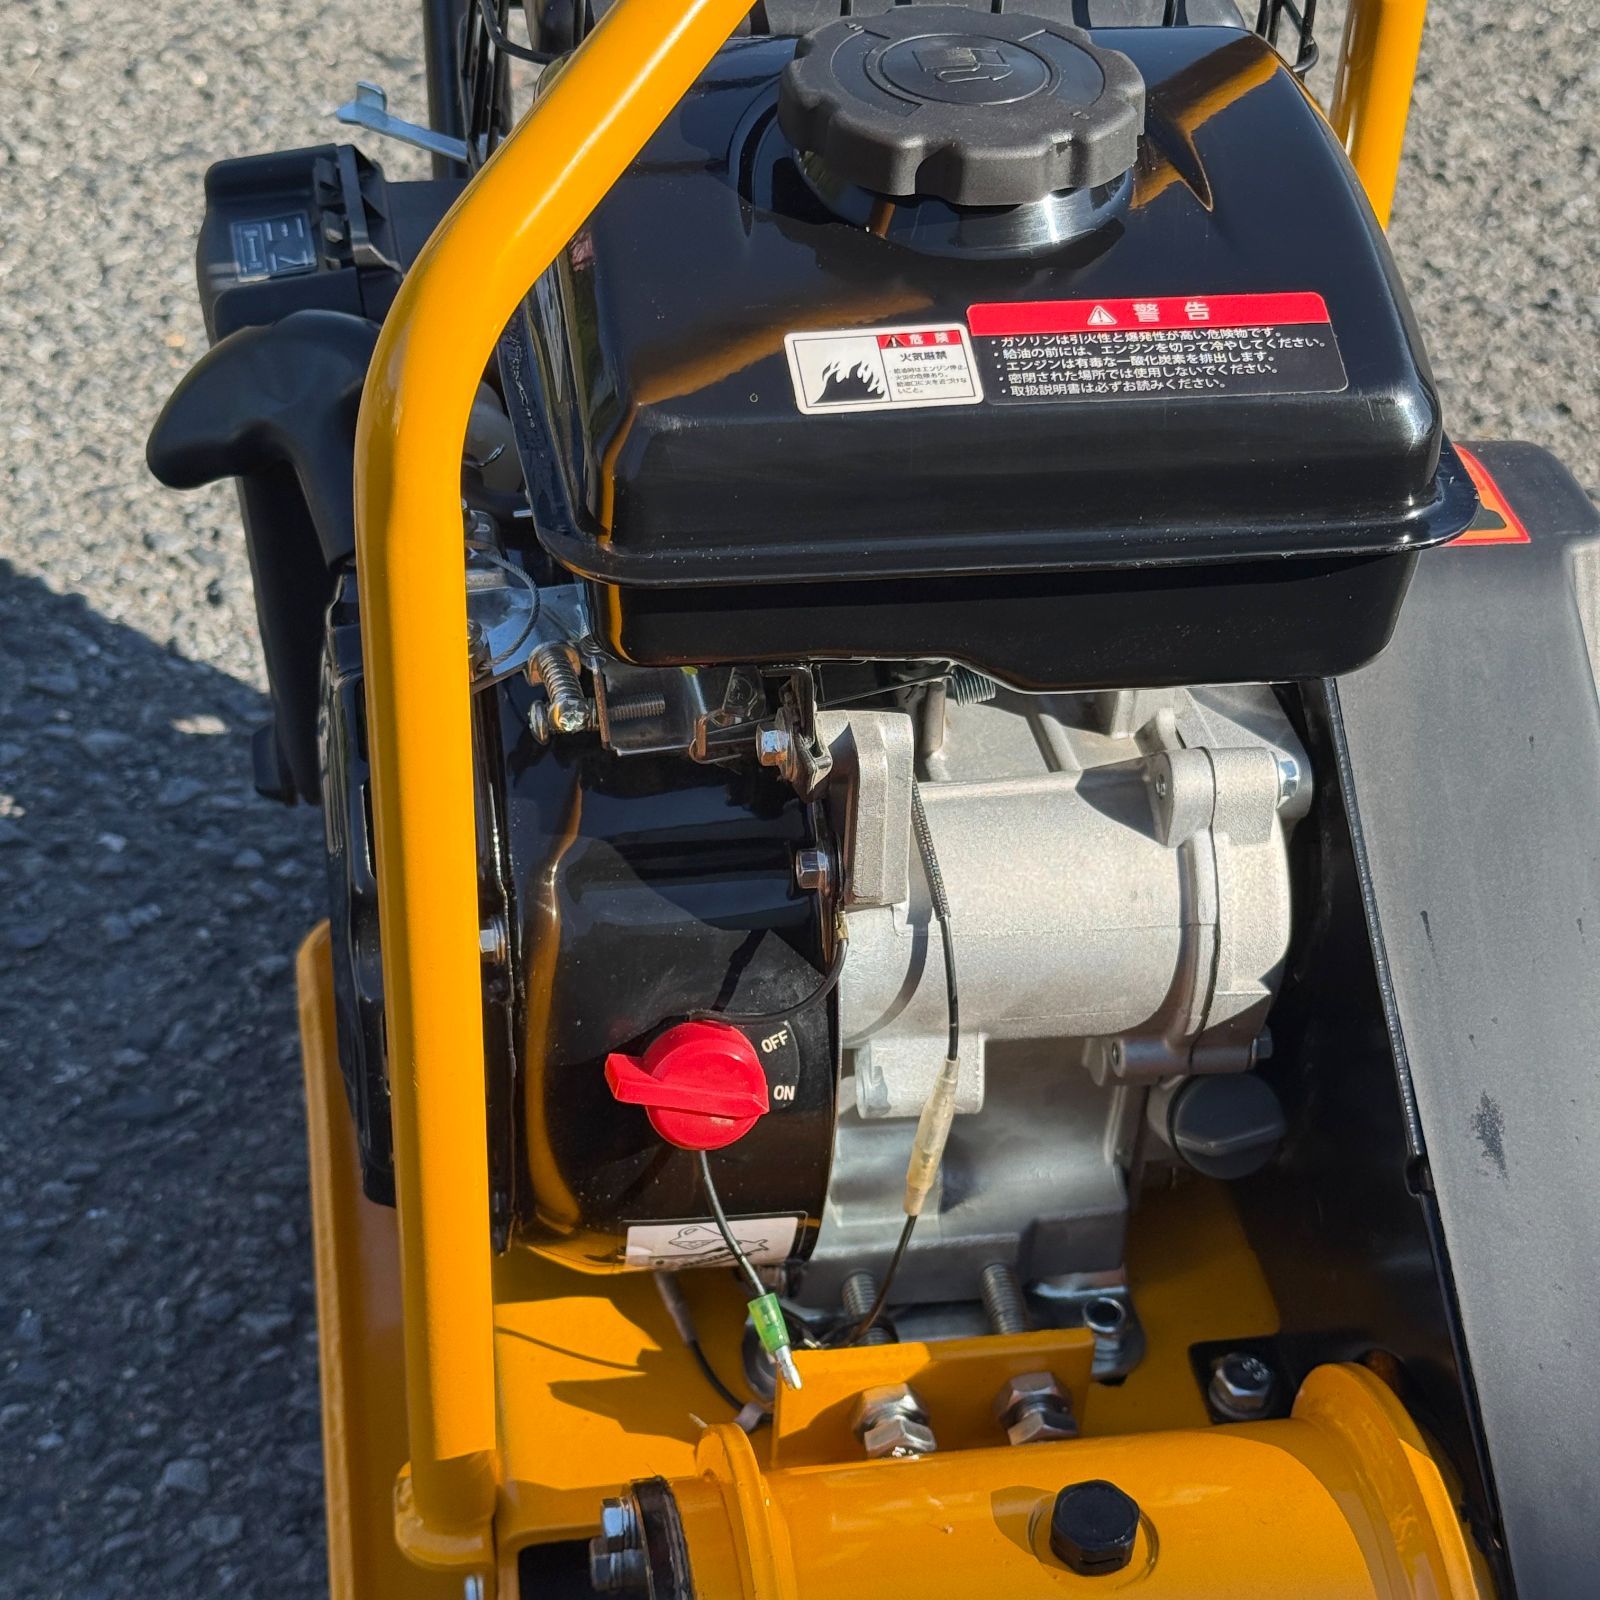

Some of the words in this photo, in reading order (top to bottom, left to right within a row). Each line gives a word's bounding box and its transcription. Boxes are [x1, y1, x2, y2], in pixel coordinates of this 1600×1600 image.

[1132, 301, 1210, 323] 警告
[1003, 337, 1326, 360] 給油の前には、エンジンを切って冷やしてください。
[1006, 351, 1275, 371] エンジンは有毒な一酸化炭素を排出します。
[1008, 364, 1278, 384] 密閉された場所では使用しないでください。
[1010, 378, 1226, 397] 取扱説明書は必ずお読みください。
[761, 1030, 789, 1053] OFF
[773, 1085, 796, 1101] ON
